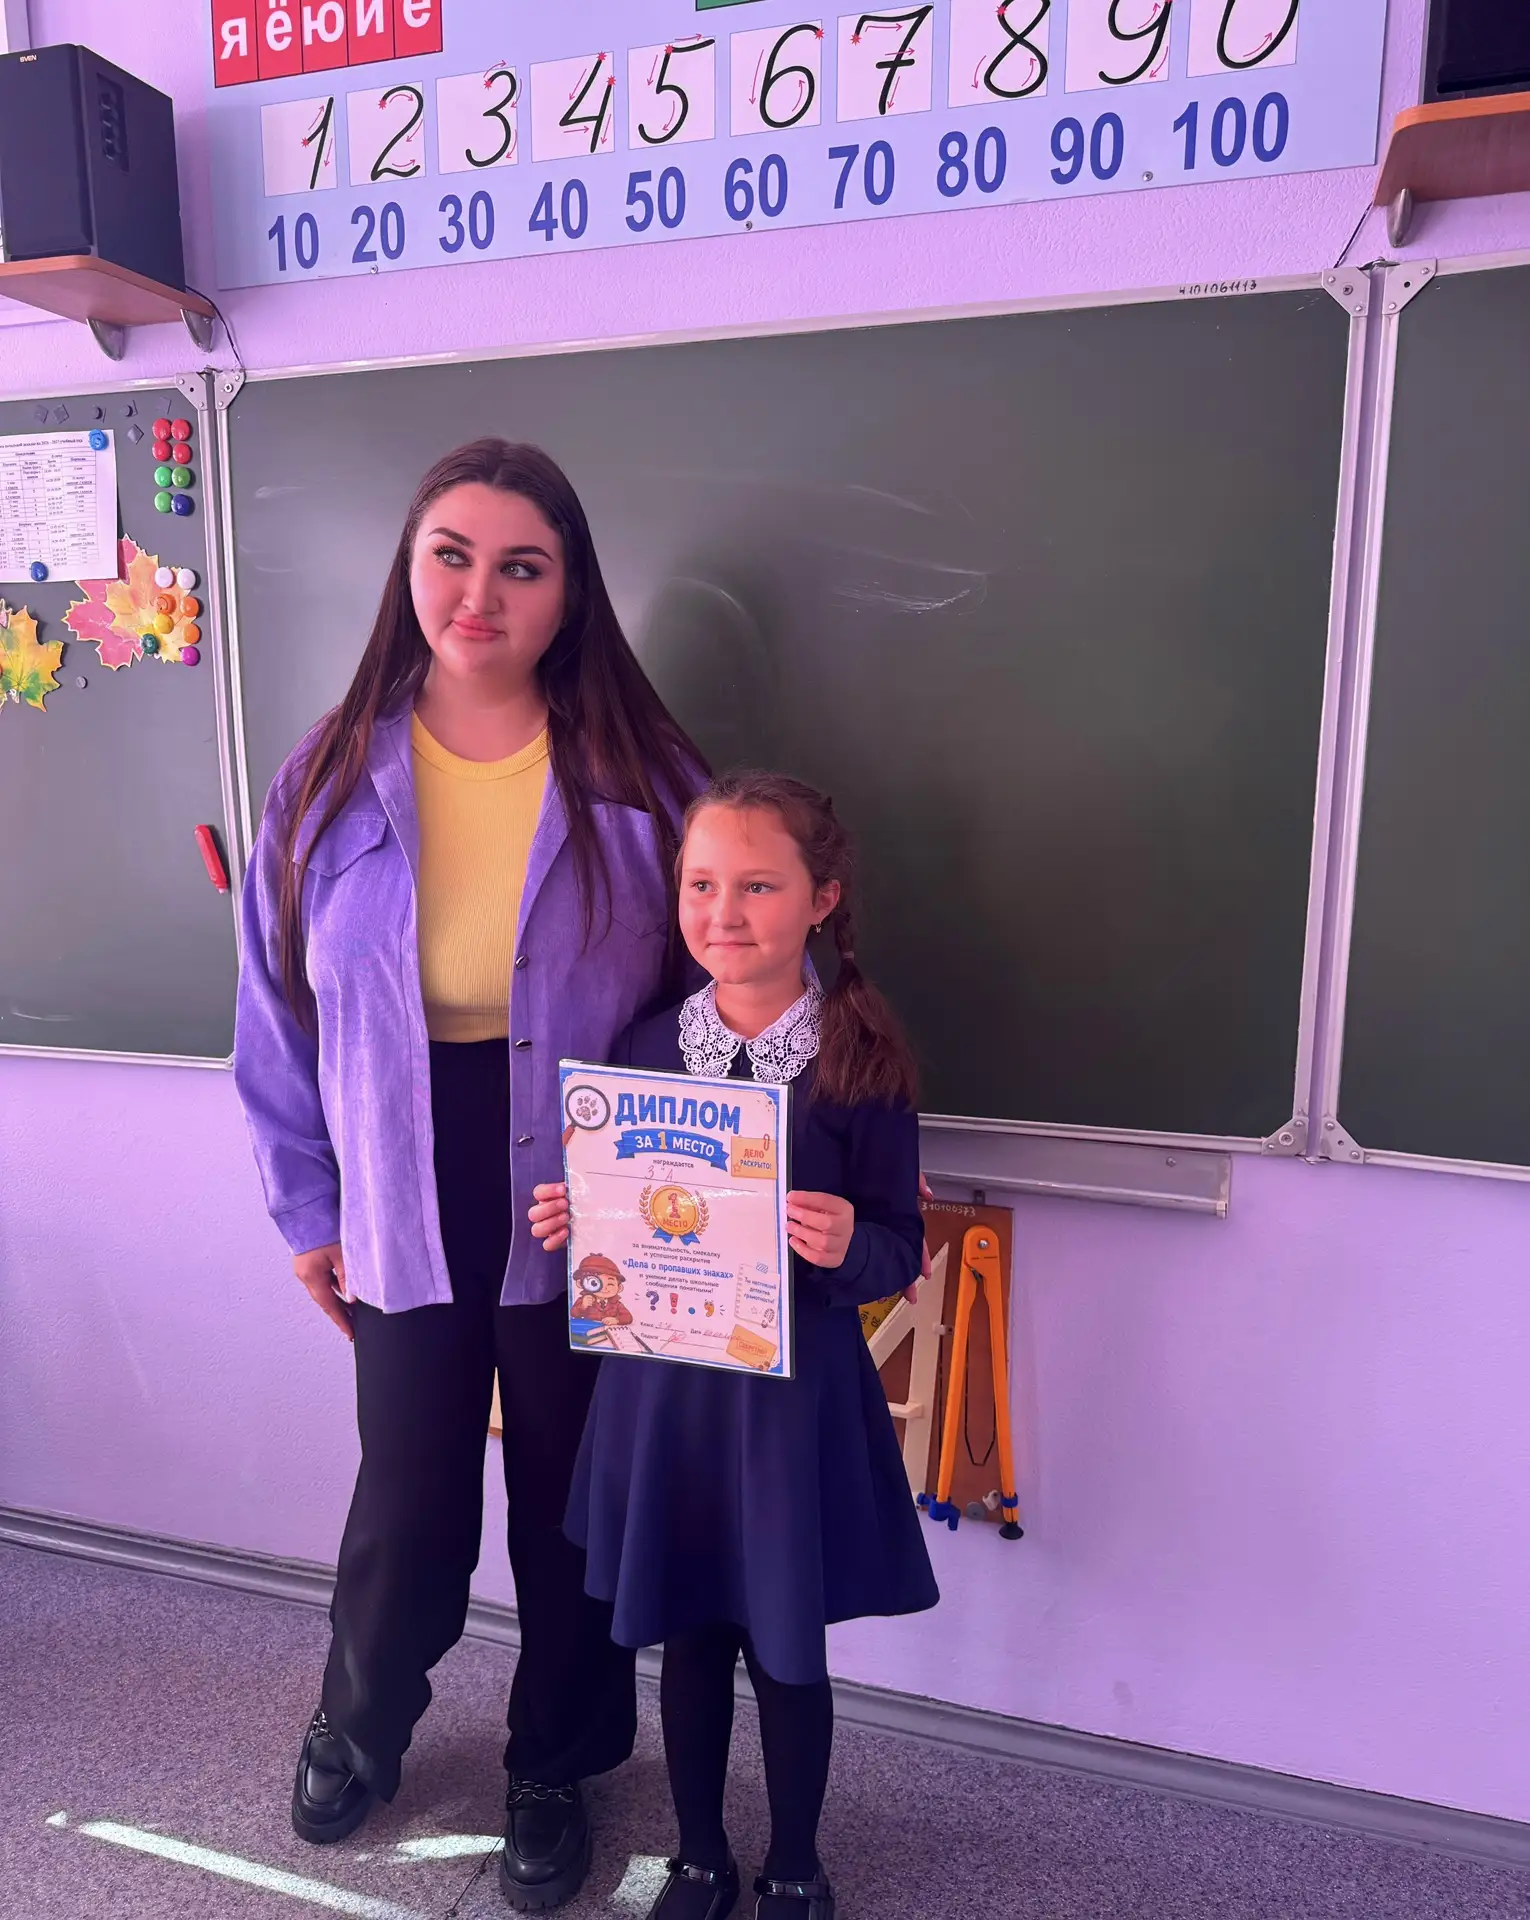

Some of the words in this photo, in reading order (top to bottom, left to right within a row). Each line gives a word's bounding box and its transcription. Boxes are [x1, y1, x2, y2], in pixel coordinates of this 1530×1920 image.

[220, 17, 248, 60] я
[265, 0, 293, 51] ё
[303, 1, 345, 46] ю
[19, 54, 37, 63] SVEN
[304, 96, 335, 190] 1
[370, 85, 424, 182] 2
[465, 69, 517, 167] 3
[558, 54, 614, 153] 4
[637, 38, 716, 144] 5
[759, 23, 822, 129] 6
[853, 4, 934, 116] 7
[983, 0, 1051, 98] 8
[1098, 0, 1174, 85] 9
[268, 212, 319, 272] 10
[350, 201, 406, 264] 20
[438, 190, 495, 254] 30
[528, 178, 589, 242] 40
[625, 166, 686, 232] 50
[724, 153, 788, 222] 60
[828, 140, 895, 210] 70
[936, 126, 1007, 198] 80
[1050, 112, 1125, 185] 90
[1172, 91, 1290, 171] 100
[614, 1092, 741, 1135] ДИПЛОМ
[634, 1135, 654, 1149] ЗА
[657, 1130, 668, 1150] 1
[672, 1136, 715, 1157] МЕСТО
[743, 1148, 765, 1160] ДЕЛО
[652, 1159, 695, 1169] награждается
[739, 1159, 772, 1171] РАСКРЫТО!
[668, 1192, 681, 1219] 1
[662, 1218, 688, 1228] МЕСТО
[622, 1258, 649, 1269] «Дела
[658, 1262, 701, 1275] пропавших
[702, 1268, 734, 1279] знаках»
